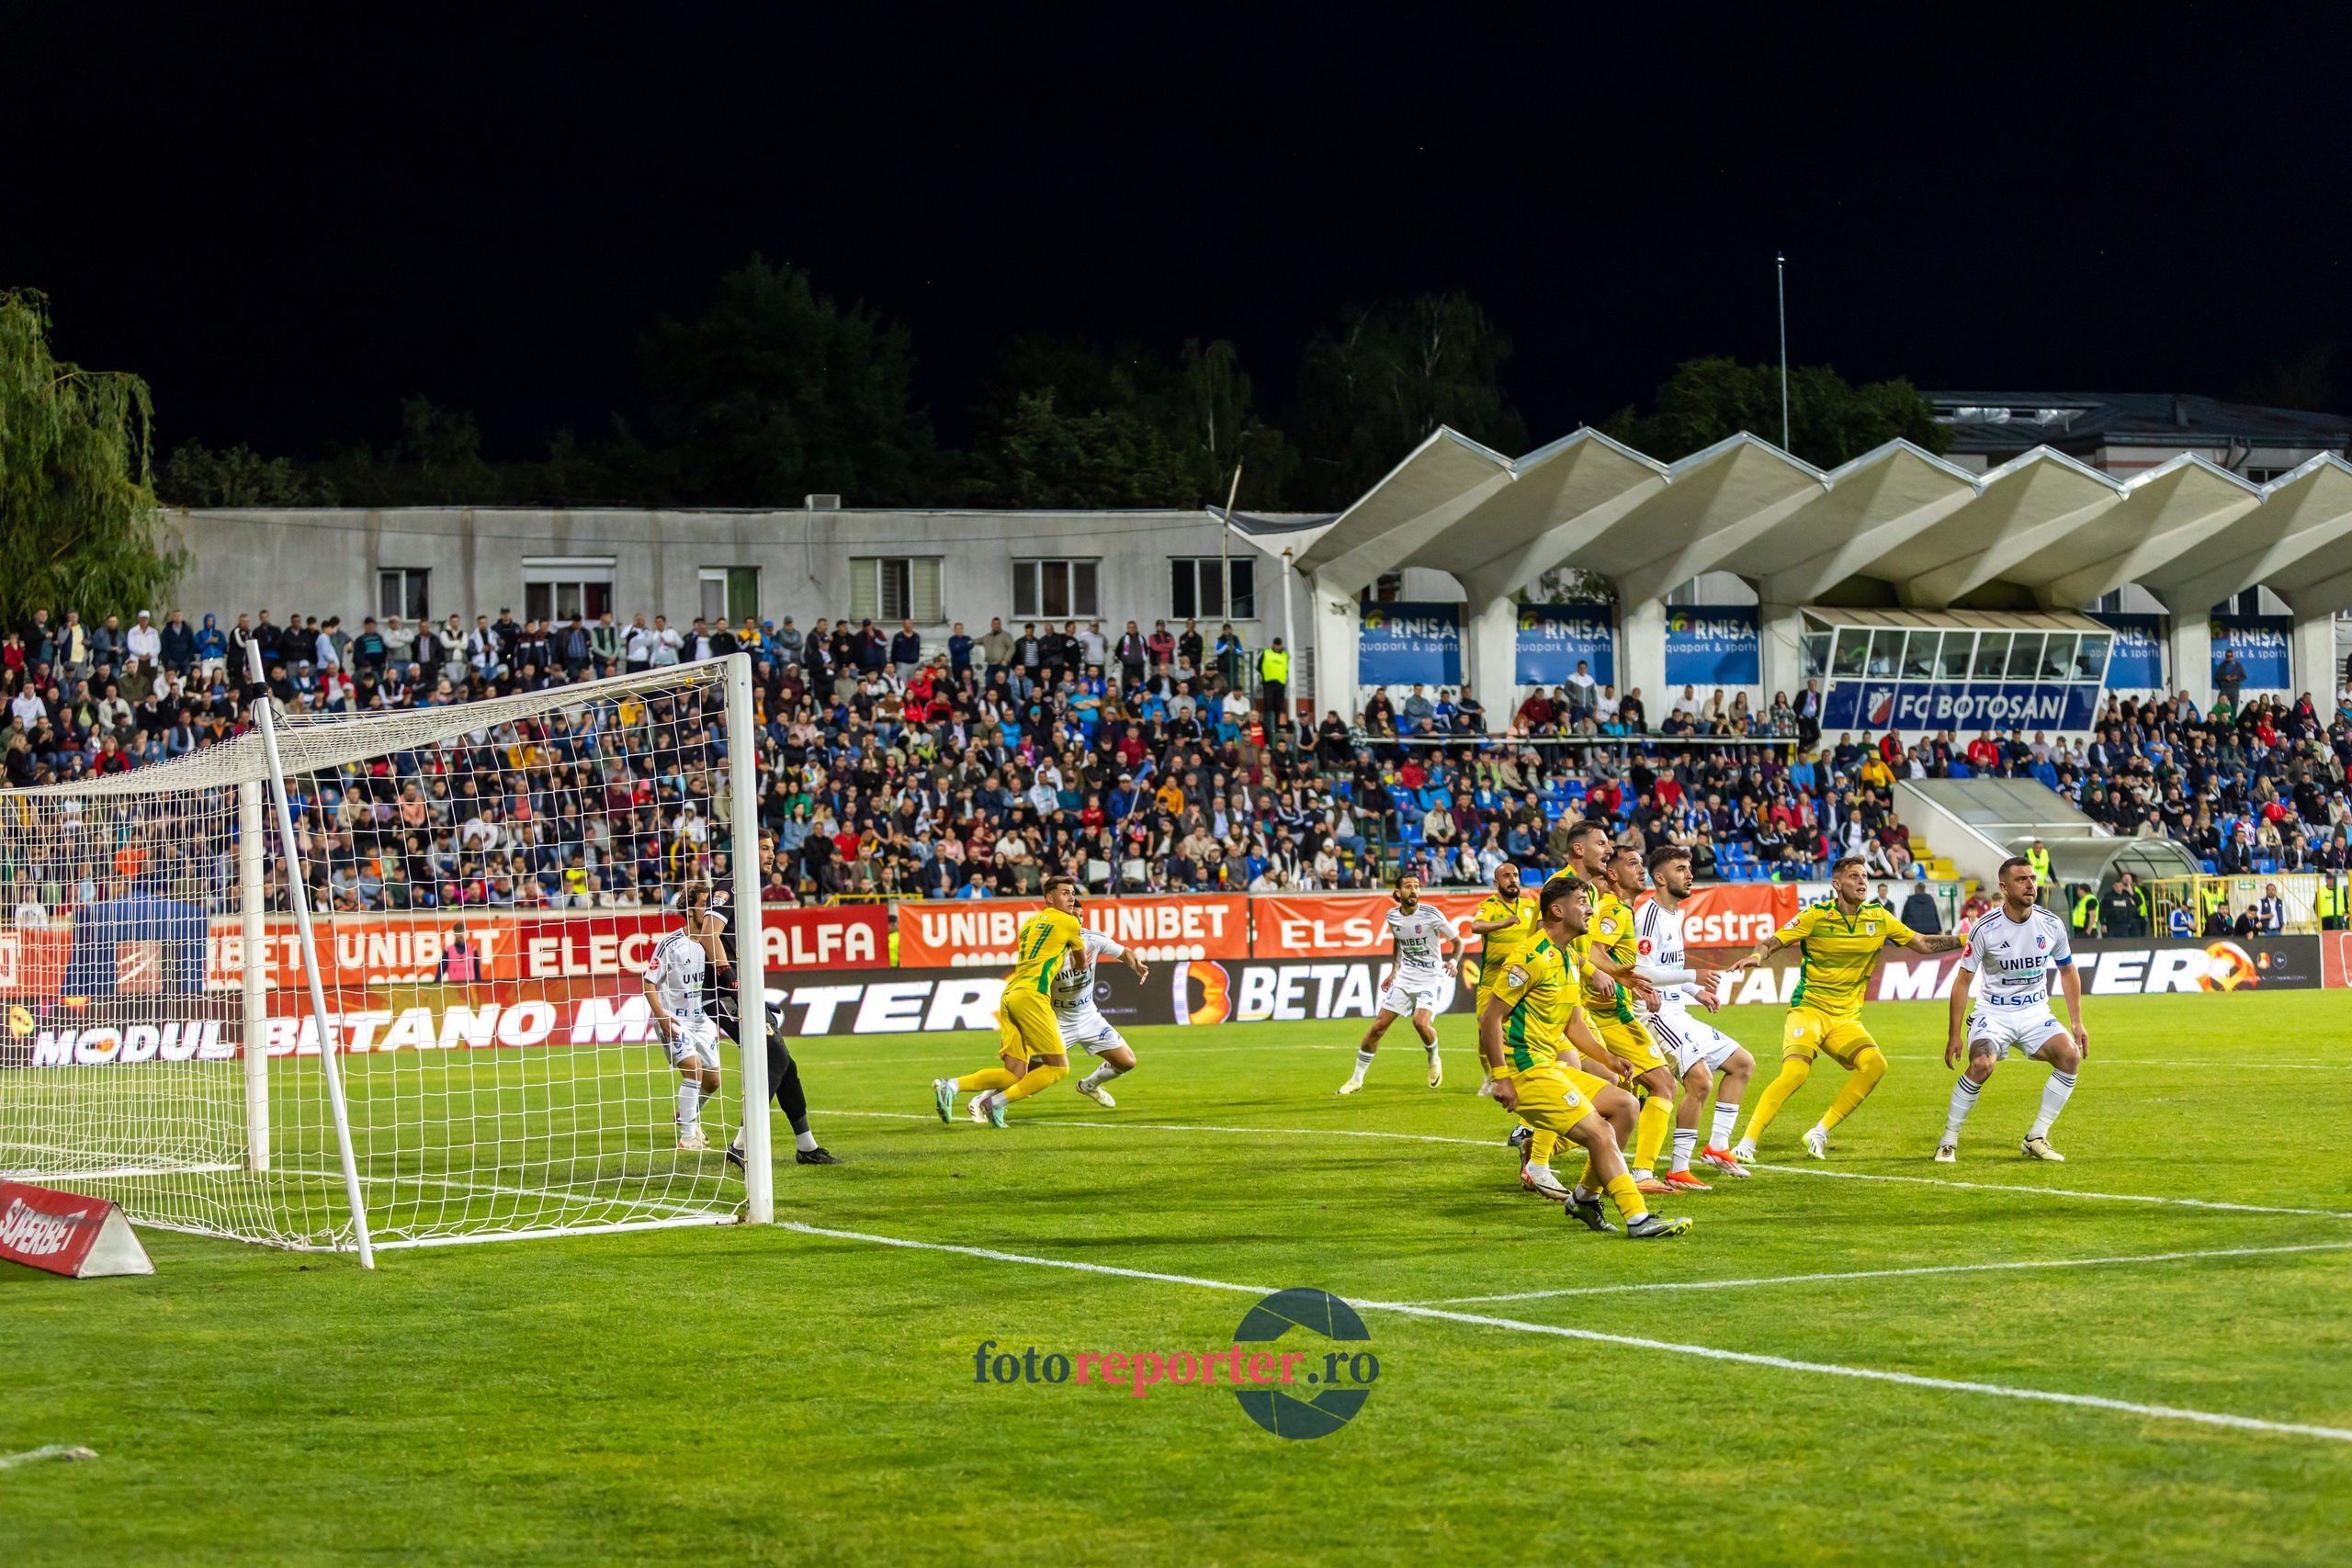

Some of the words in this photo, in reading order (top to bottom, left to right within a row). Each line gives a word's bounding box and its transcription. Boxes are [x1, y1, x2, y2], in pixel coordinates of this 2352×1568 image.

[1412, 641, 1420, 651] &
[1425, 643, 1459, 653] sports
[1566, 642, 1574, 652] &
[1714, 642, 1722, 651] &
[1725, 644, 1758, 653] sports
[2247, 649, 2256, 659] &
[1899, 695, 1930, 719] FC
[1090, 905, 1228, 941] UNIBET
[1019, 923, 1055, 961] 17
[1999, 955, 2049, 971] UNIBET
[1055, 963, 1093, 982] UNIBET
[1990, 988, 2046, 1006] ELSACO
[31, 1021, 235, 1066] MODUL
[266, 1000, 556, 1056] BETANO
[0, 1197, 89, 1255] SUPERBET
